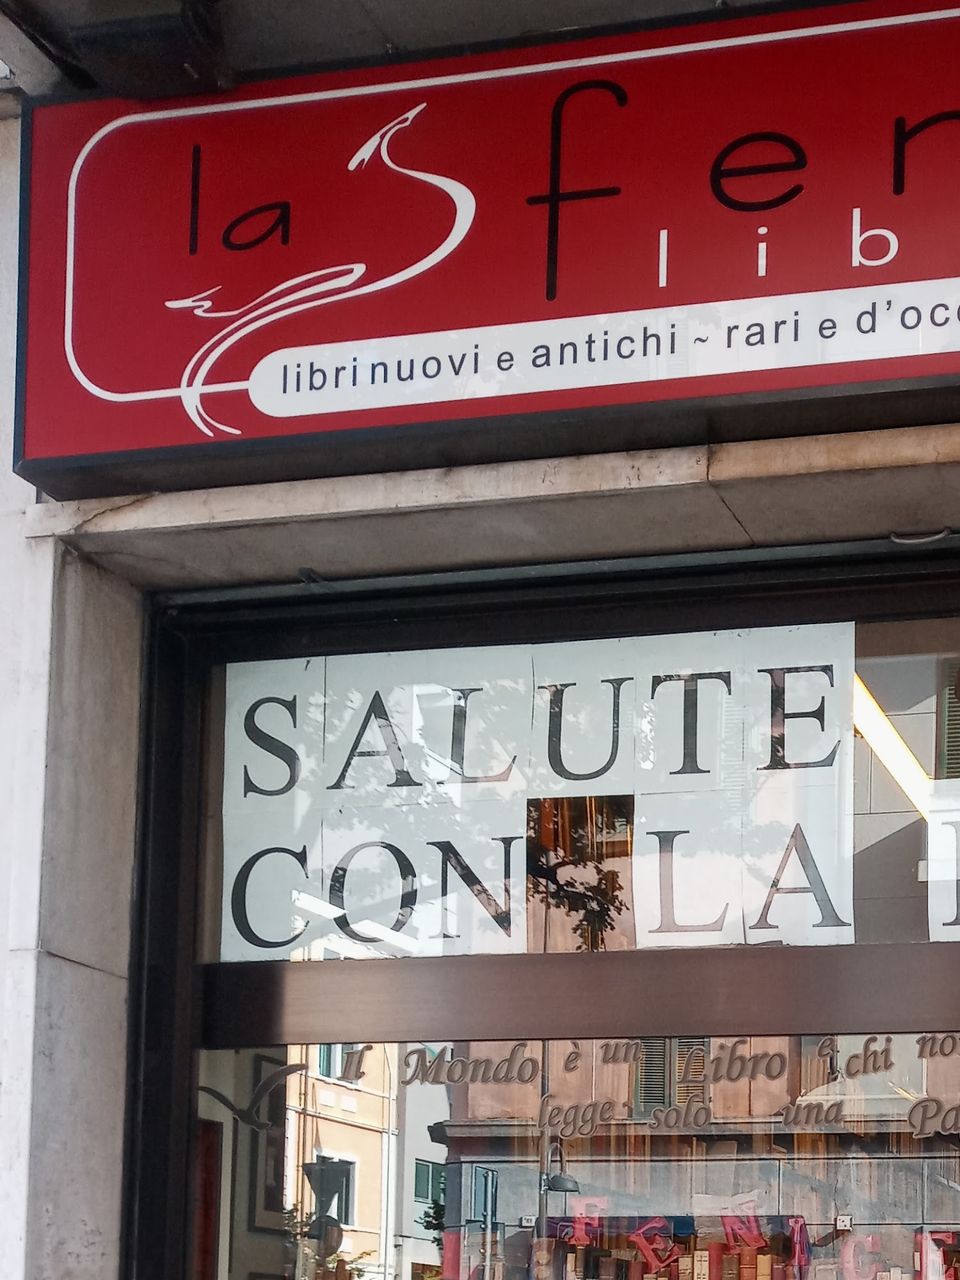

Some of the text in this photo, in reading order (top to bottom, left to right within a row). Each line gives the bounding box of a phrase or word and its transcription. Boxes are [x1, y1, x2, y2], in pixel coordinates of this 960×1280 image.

[189, 144, 291, 256] la
[496, 351, 516, 374] e
[531, 329, 677, 370] antichi
[726, 312, 801, 351] rari
[817, 317, 838, 341] e
[242, 664, 842, 798] SALUTE
[231, 835, 524, 948] CON
[646, 822, 852, 934] LA
[401, 1041, 540, 1086] Mondo
[564, 1041, 581, 1073] è
[600, 1038, 642, 1065] un
[677, 1036, 788, 1084] Libro
[844, 1035, 894, 1079] chi
[536, 1093, 615, 1139] legge
[649, 1093, 713, 1130] solo
[781, 1098, 845, 1127] una
